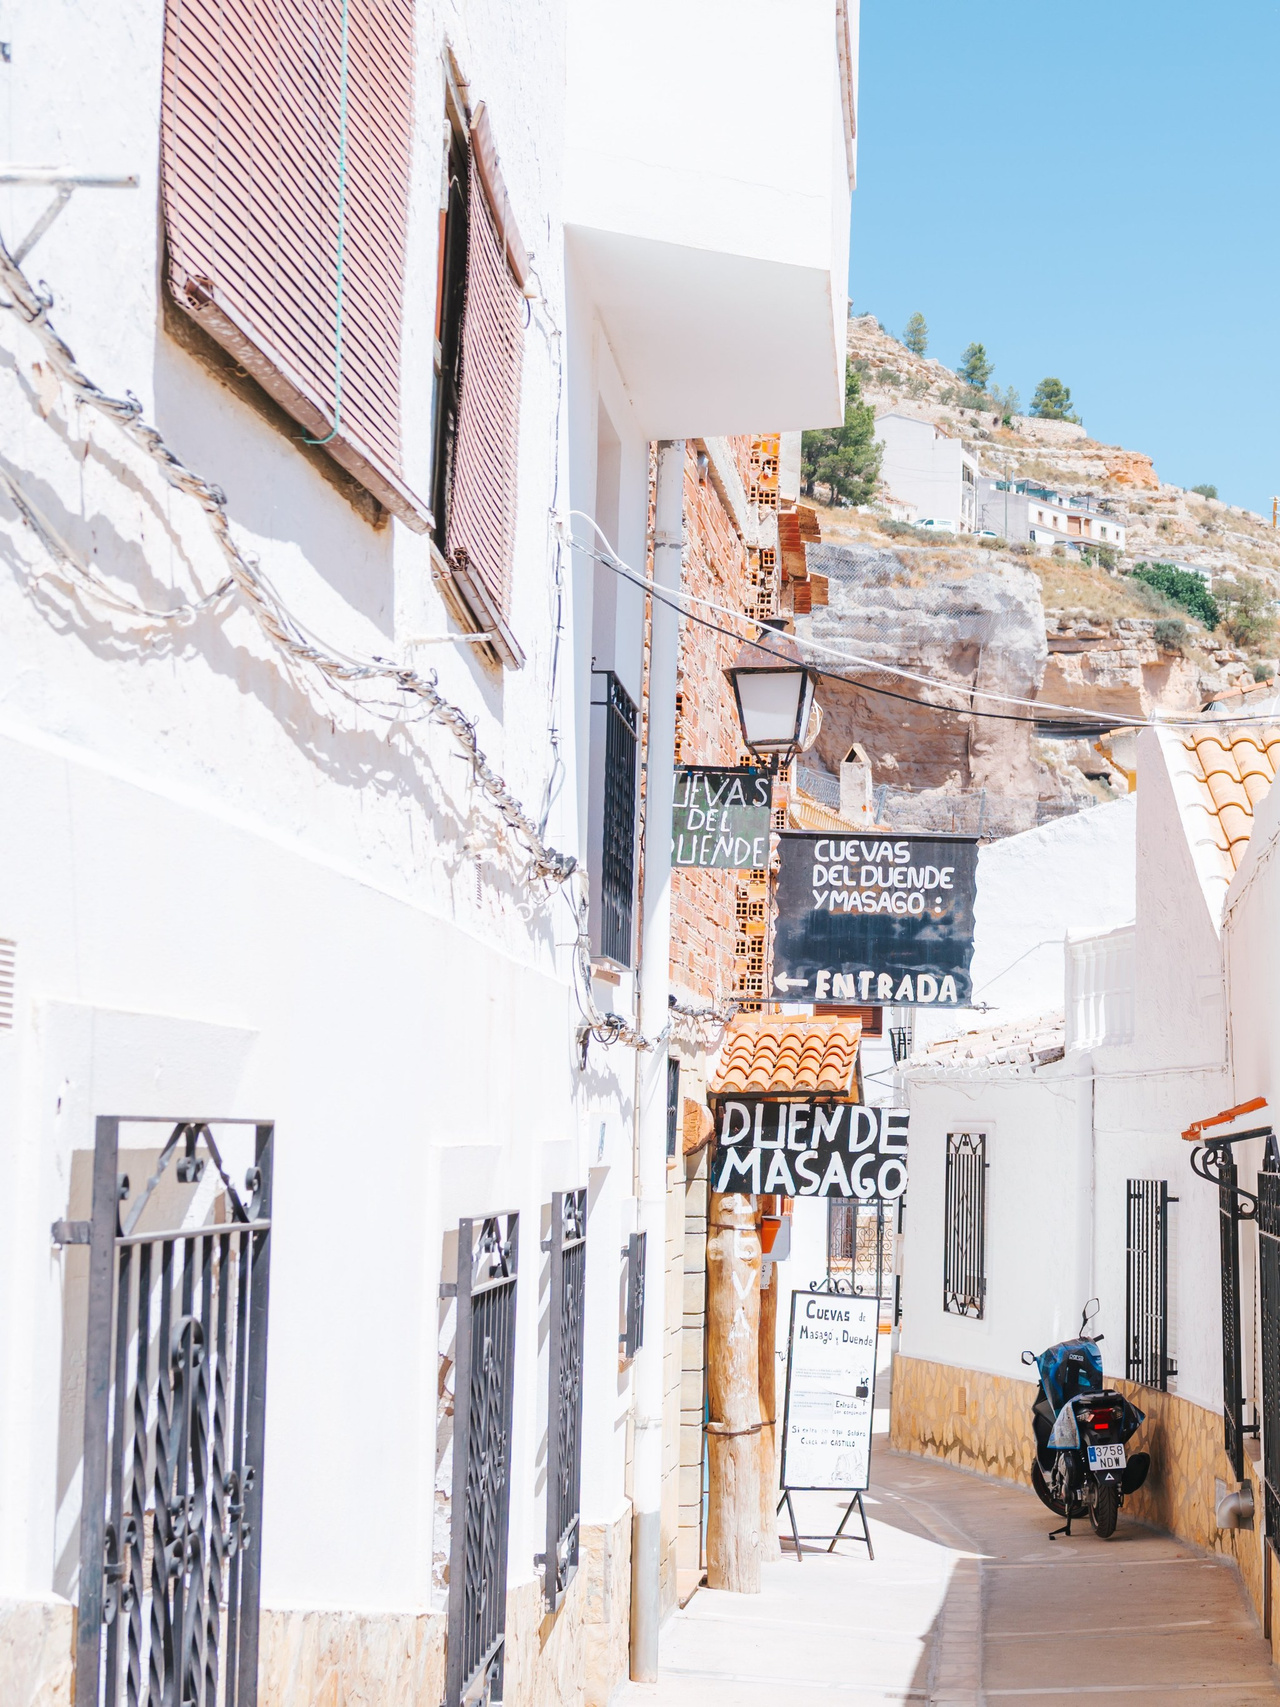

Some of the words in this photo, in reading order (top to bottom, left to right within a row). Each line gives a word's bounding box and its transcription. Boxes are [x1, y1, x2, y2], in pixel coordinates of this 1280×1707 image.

[672, 773, 769, 807] UEVAS
[687, 807, 731, 832] DEL
[814, 839, 910, 864] CUEVAS
[812, 863, 857, 887] DEL
[860, 864, 956, 890] DUENDE
[812, 889, 829, 910] Y
[829, 888, 925, 914] MASAGÓ
[815, 969, 959, 1003] ENTRADA
[720, 1101, 911, 1155] DUENDE
[717, 1147, 909, 1200] MASAGO
[842, 1329, 874, 1347] Duende
[1095, 1445, 1124, 1457] 3758
[1099, 1456, 1120, 1468] NDW
